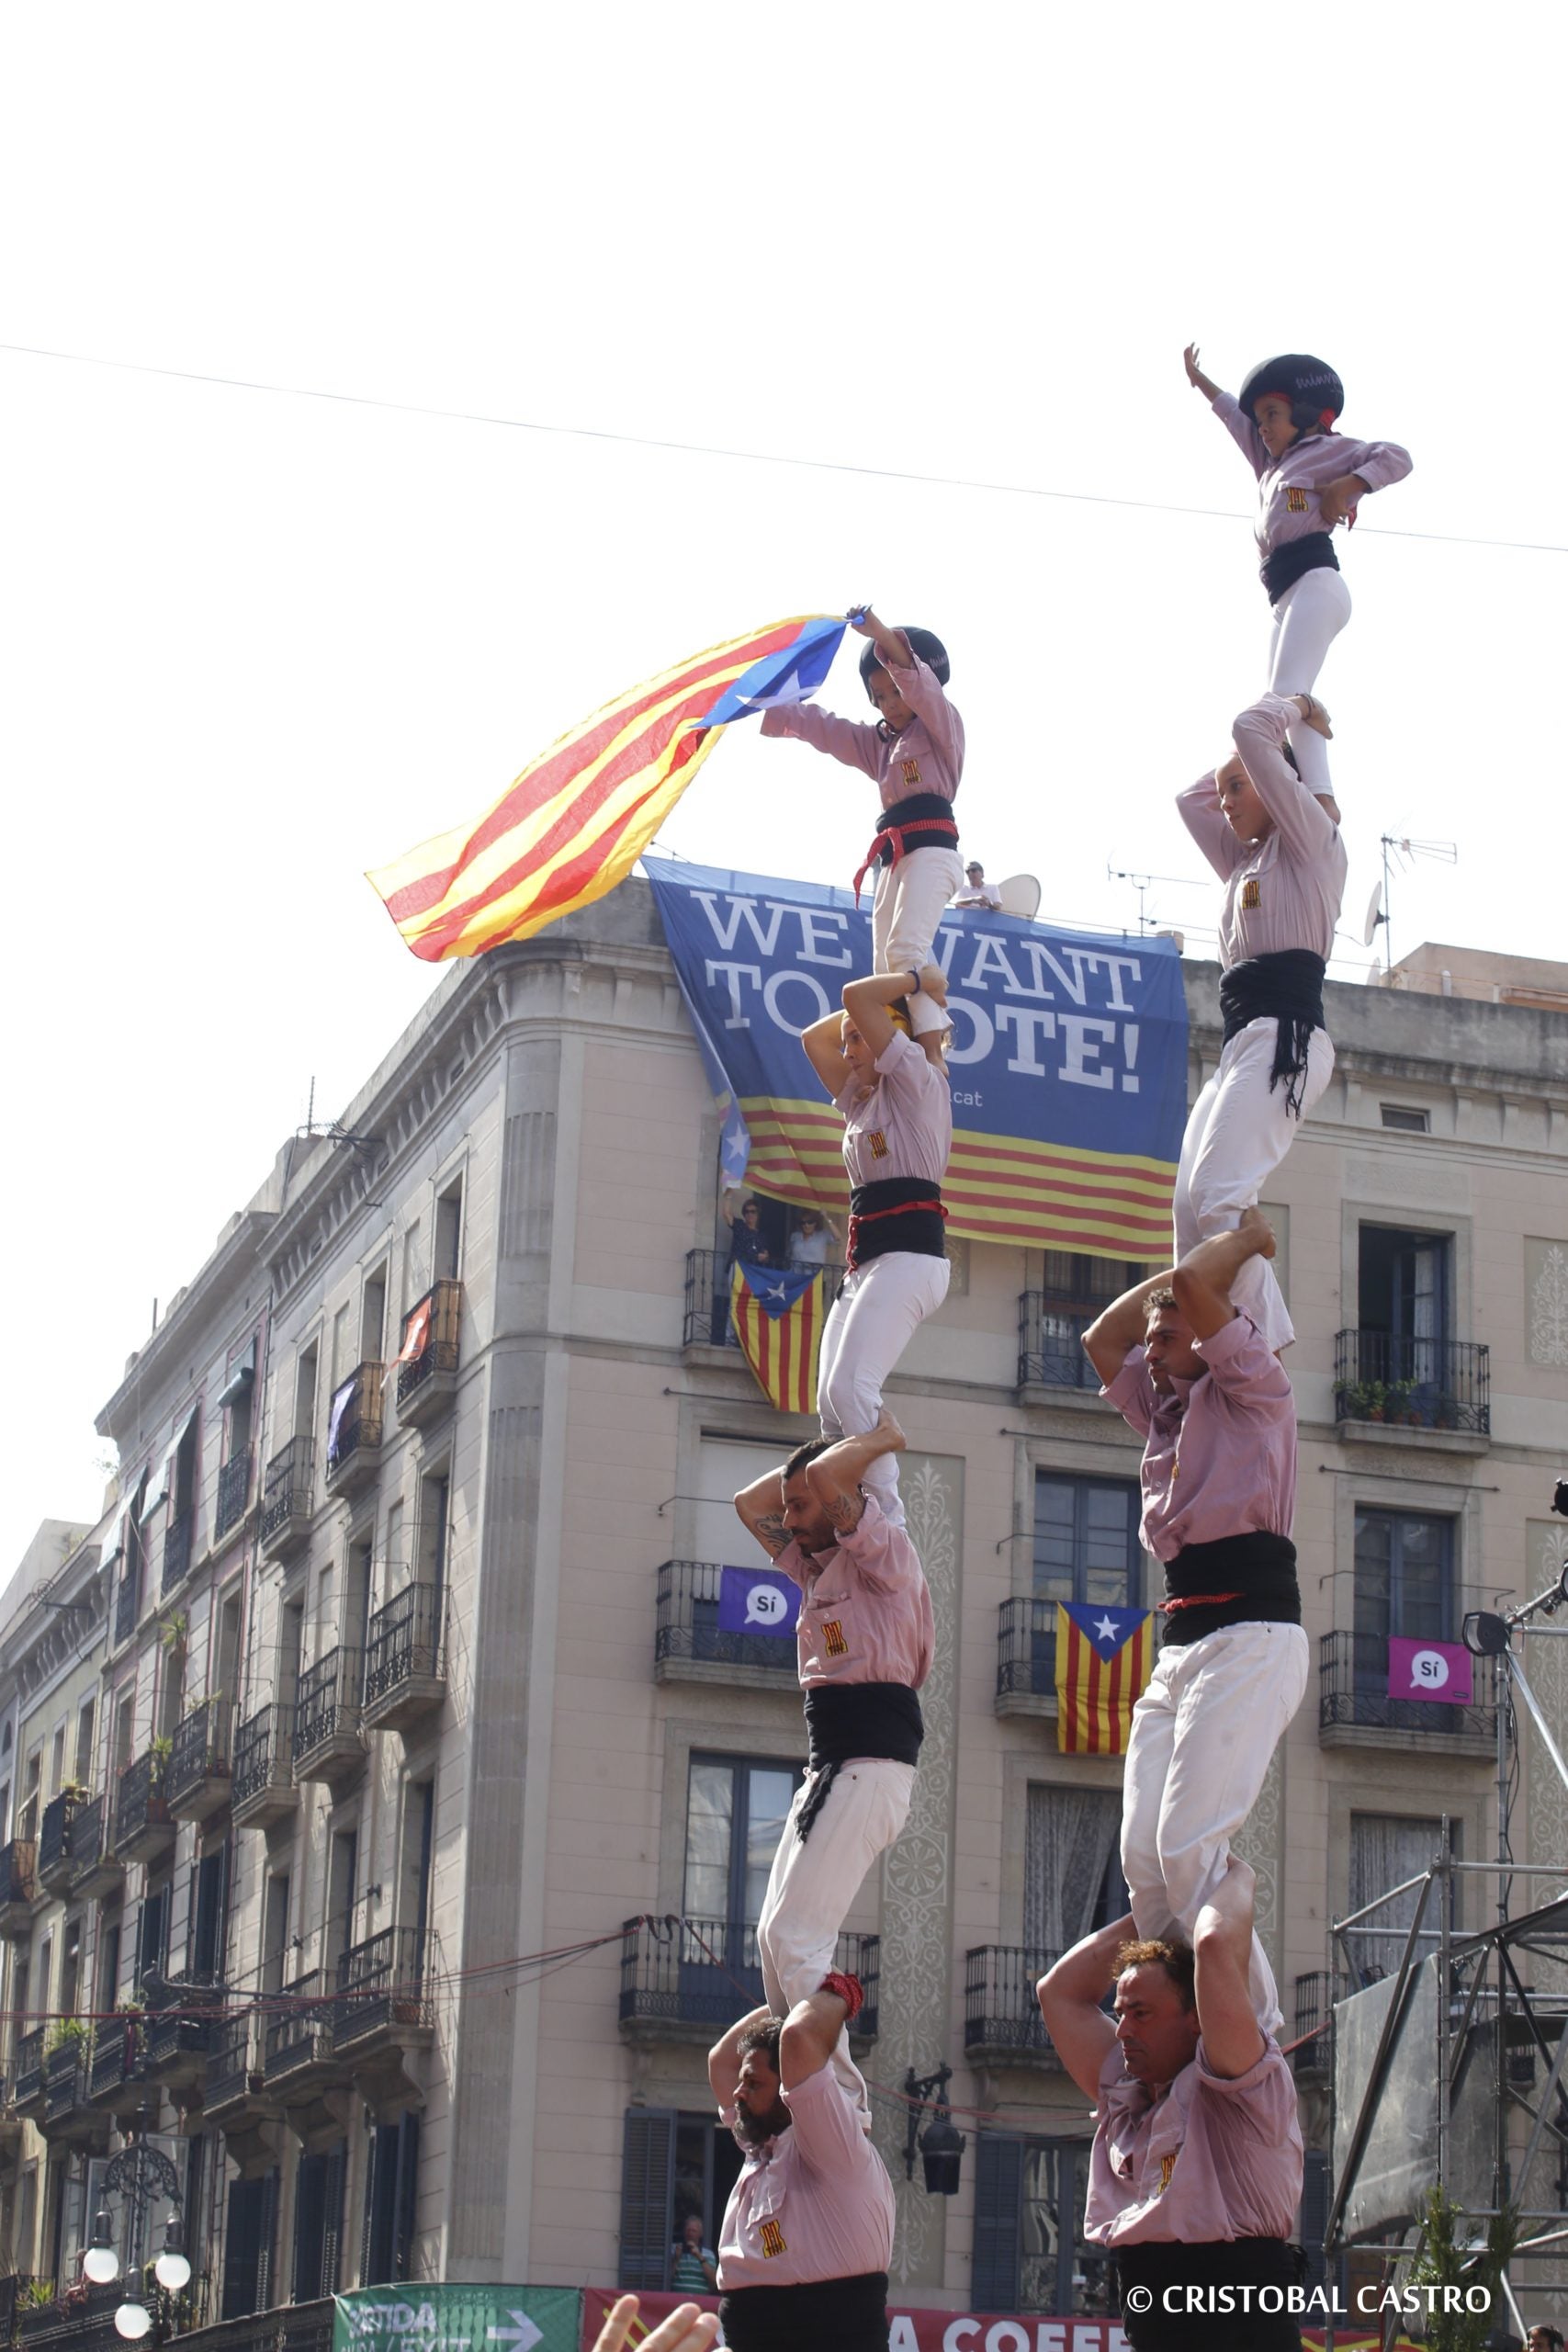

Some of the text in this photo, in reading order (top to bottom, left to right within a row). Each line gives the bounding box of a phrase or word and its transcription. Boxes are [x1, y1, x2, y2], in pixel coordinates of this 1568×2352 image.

[690, 889, 852, 969] WE
[705, 959, 1140, 1093] TO OTE!
[756, 1596, 776, 1612] Sí
[1421, 1661, 1439, 1678] Sí
